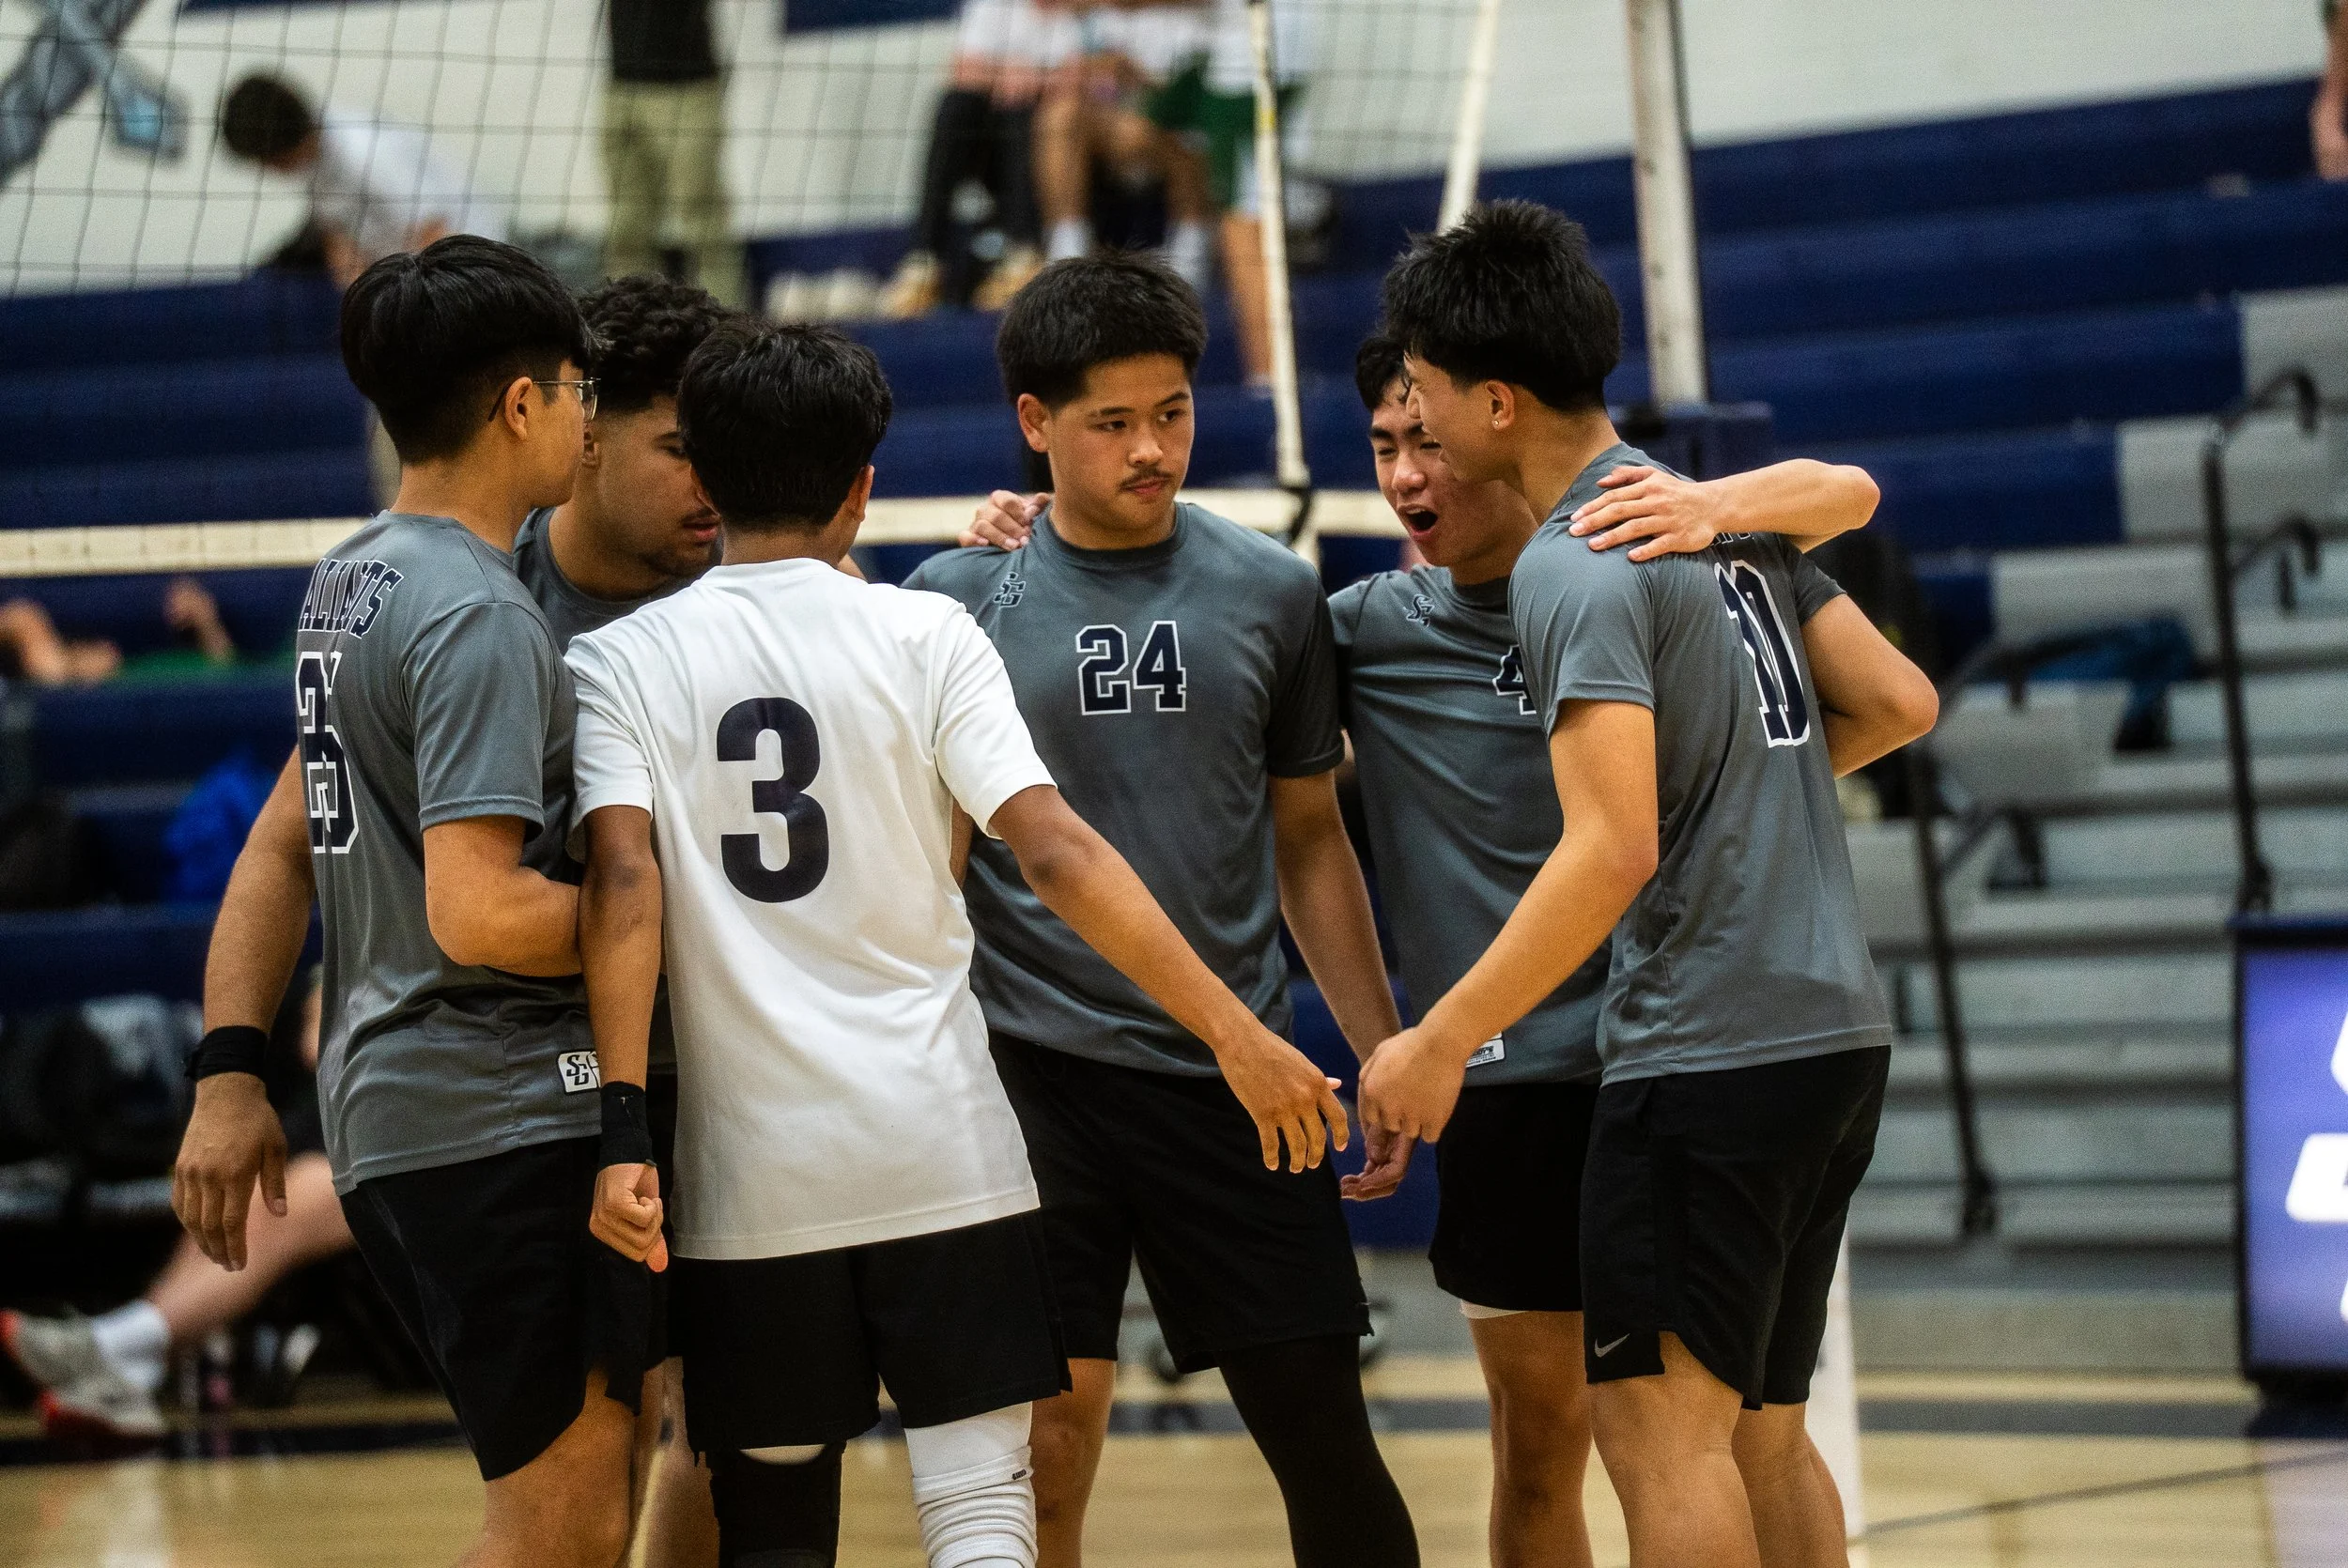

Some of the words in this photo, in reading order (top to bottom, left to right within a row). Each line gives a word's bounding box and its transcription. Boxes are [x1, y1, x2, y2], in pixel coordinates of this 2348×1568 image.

[1075, 621, 1186, 715] 24
[1714, 560, 1811, 748] 10
[717, 697, 829, 903] 3
